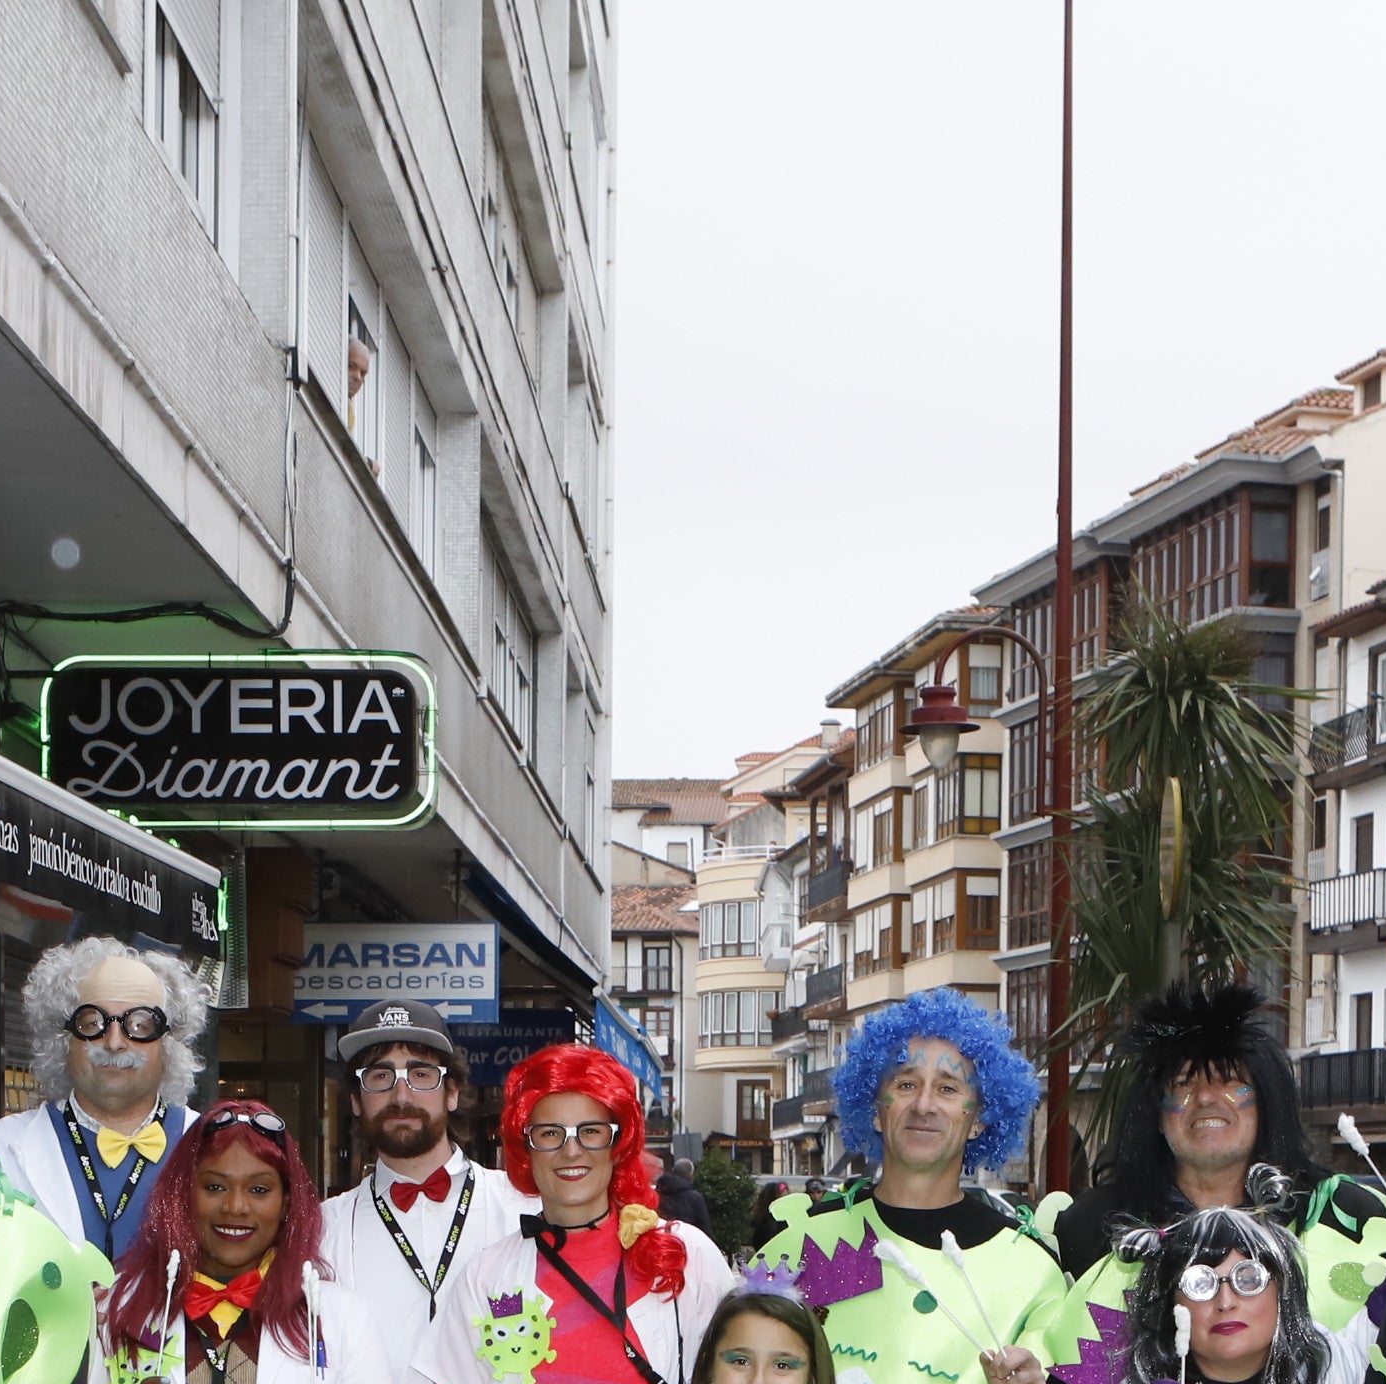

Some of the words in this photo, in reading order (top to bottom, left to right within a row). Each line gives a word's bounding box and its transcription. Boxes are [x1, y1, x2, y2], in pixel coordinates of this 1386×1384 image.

[68, 677, 402, 735] JOYERIA
[66, 740, 401, 800] Diamant
[27, 819, 63, 875] jamón
[379, 1010, 410, 1023] VANS
[80, 1155, 96, 1181] deone
[128, 1158, 145, 1185] deone
[394, 1231, 413, 1257] deone
[445, 1225, 461, 1254] deone
